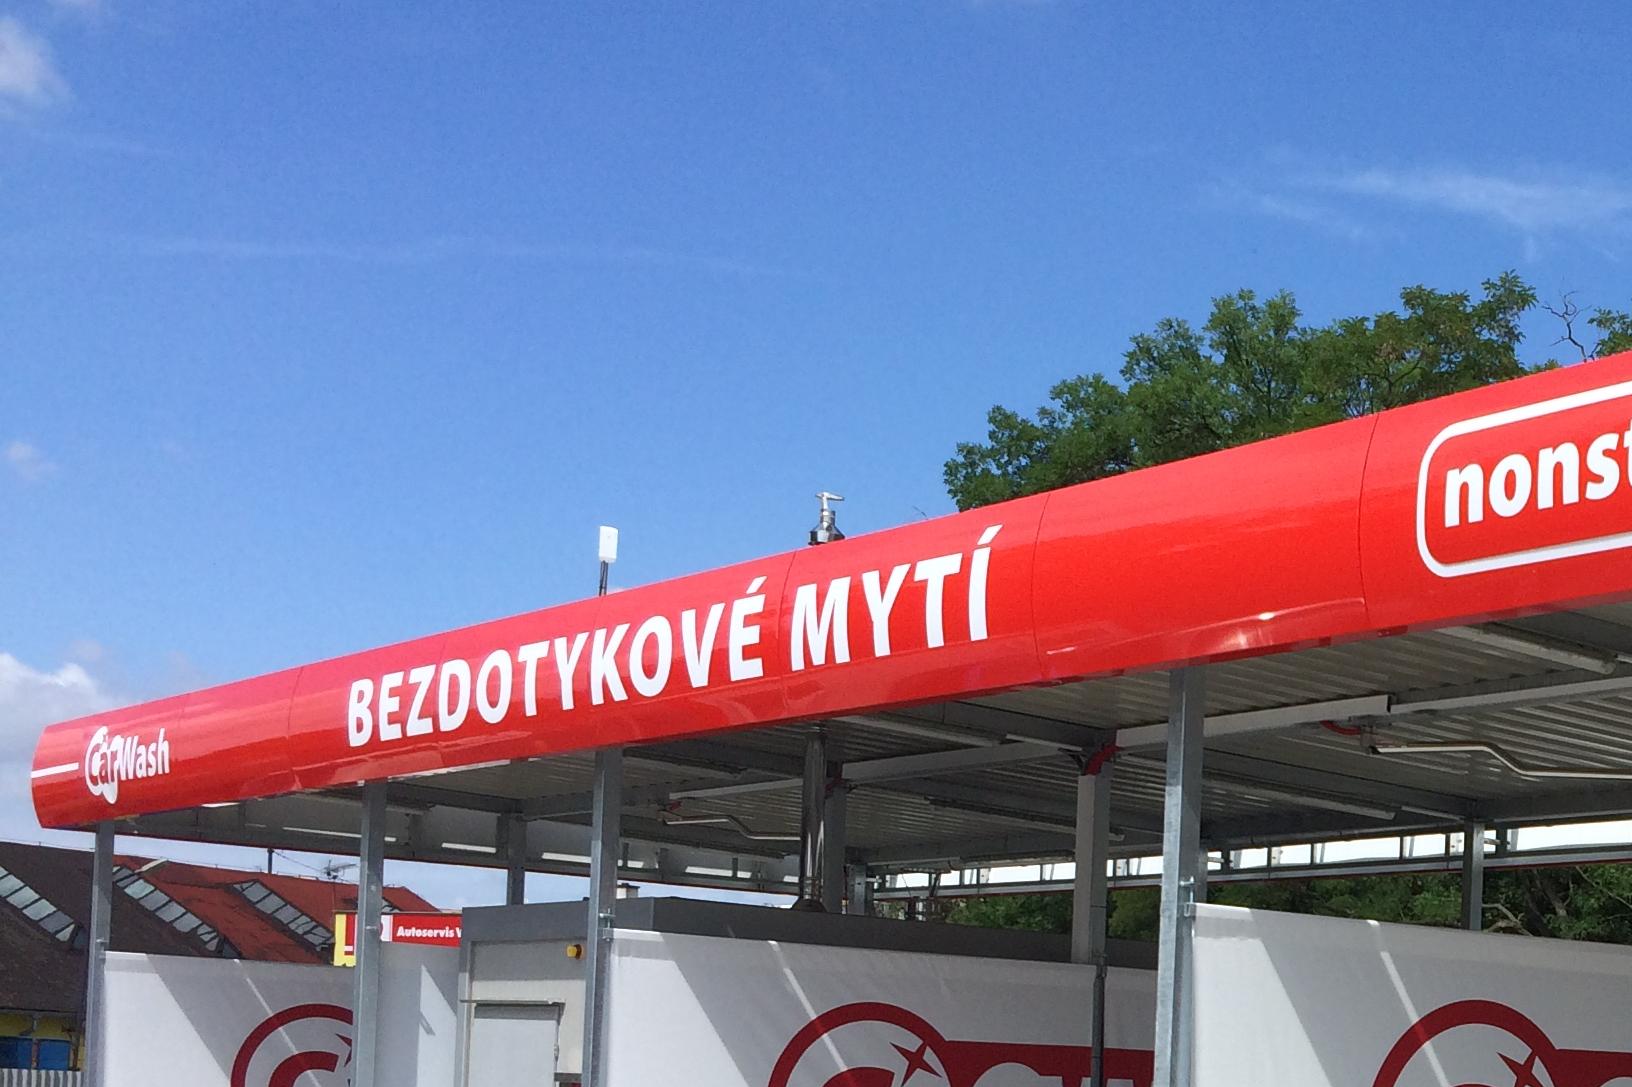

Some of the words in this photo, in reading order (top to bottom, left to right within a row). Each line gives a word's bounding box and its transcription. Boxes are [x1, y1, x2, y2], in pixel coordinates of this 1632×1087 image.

[347, 576, 767, 747] BEZDOTYKOVÉ
[791, 524, 1003, 673] MYTÍ
[87, 727, 170, 790] CarWash
[396, 926, 455, 938] Autoservis
